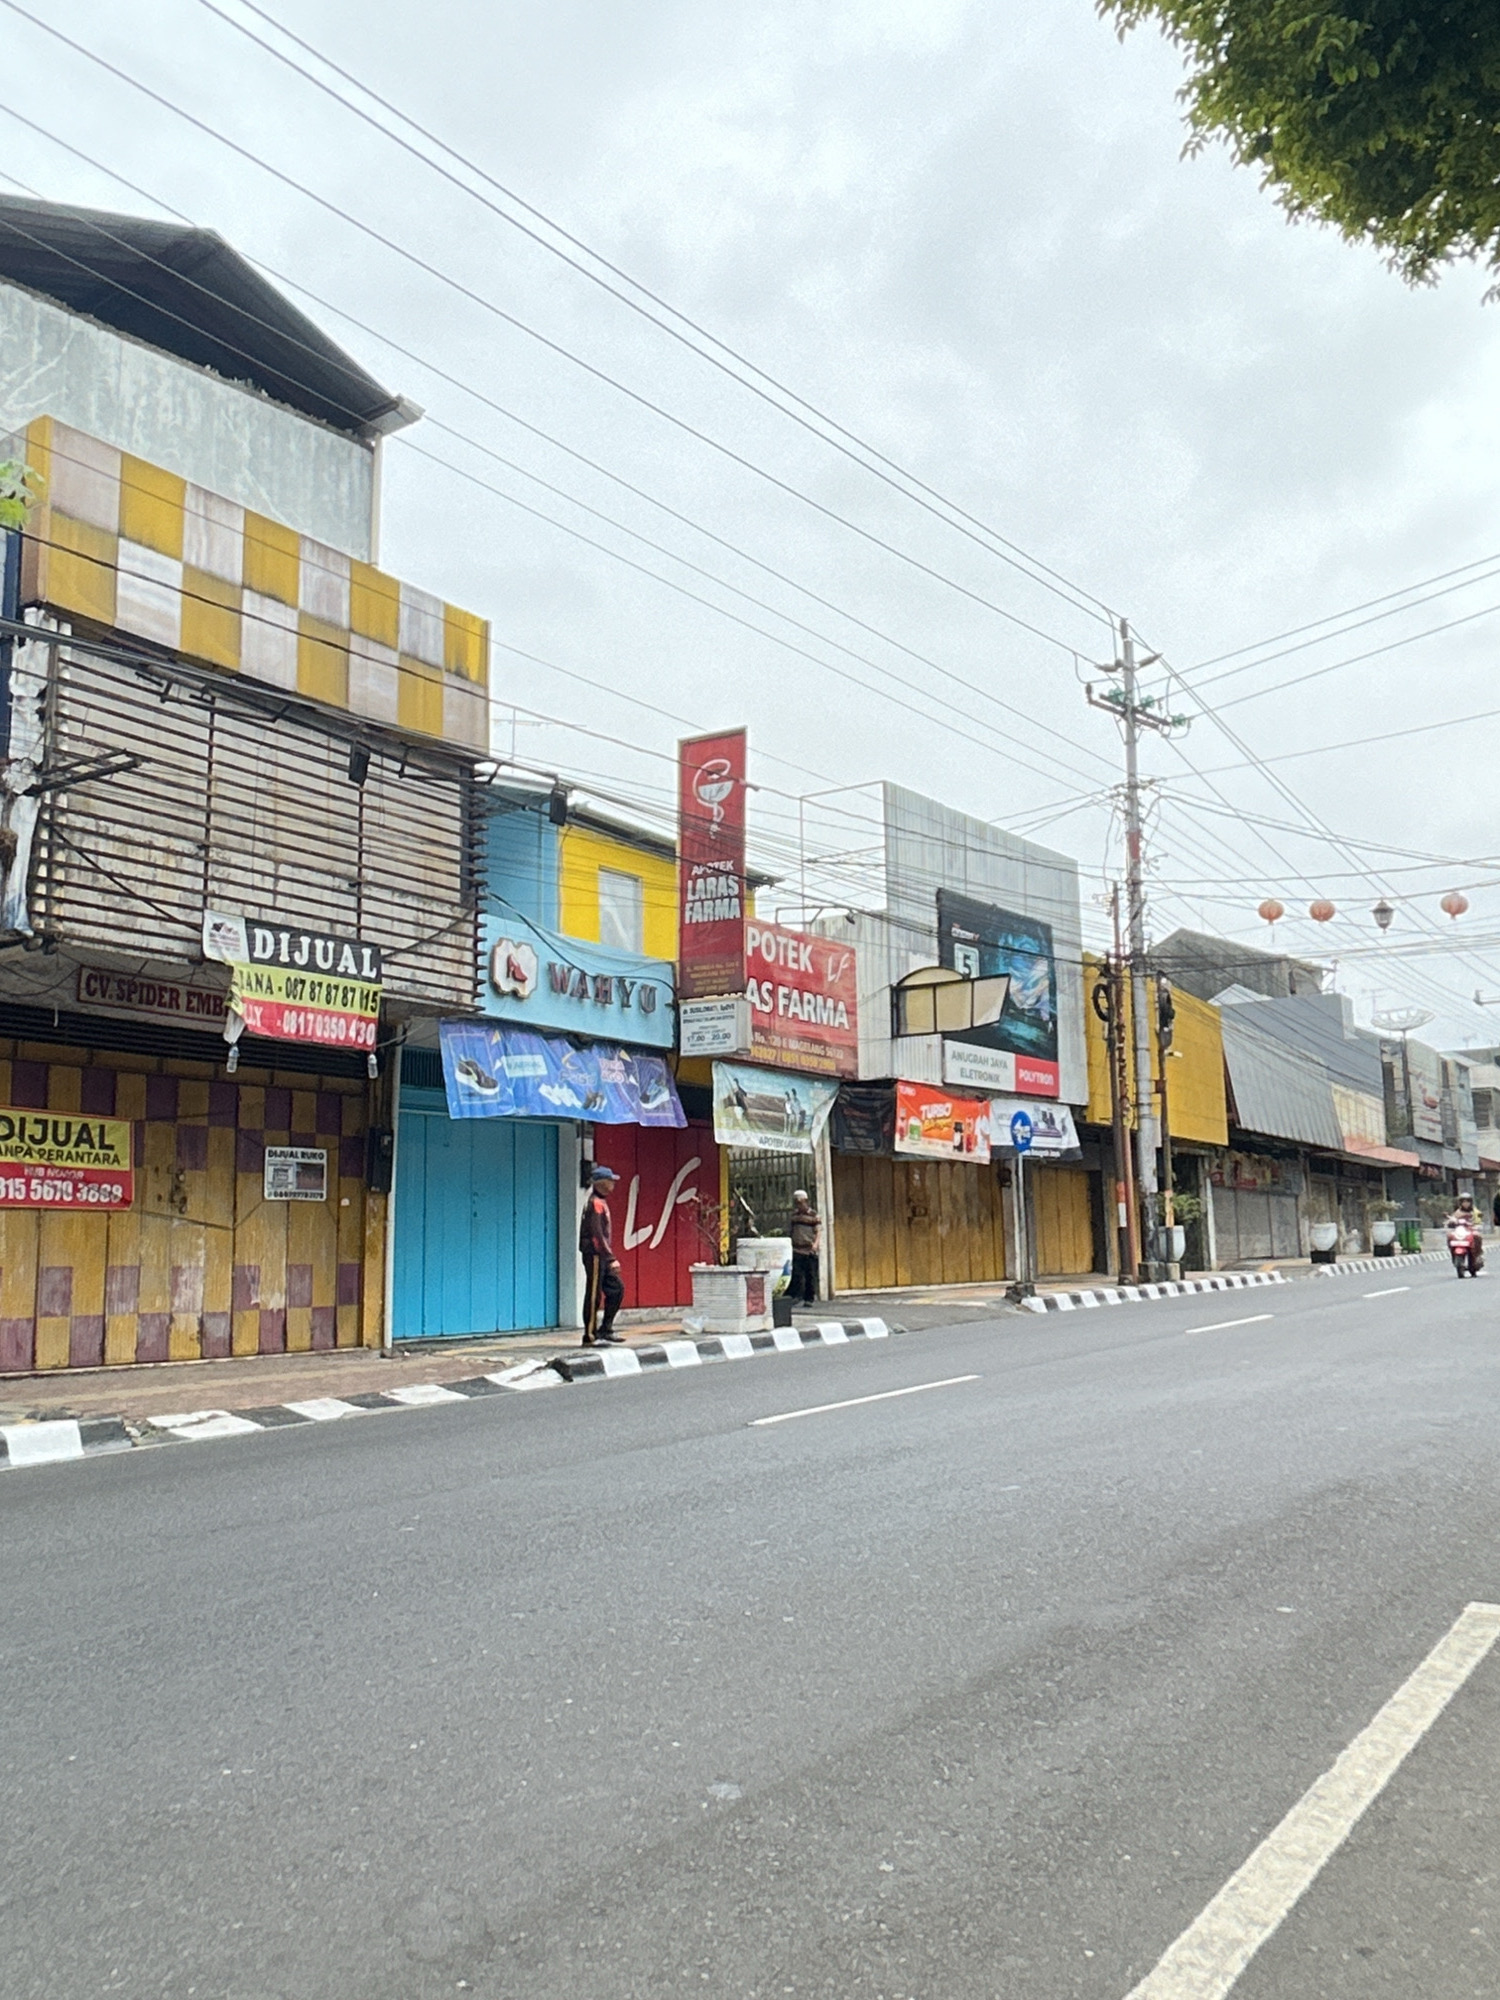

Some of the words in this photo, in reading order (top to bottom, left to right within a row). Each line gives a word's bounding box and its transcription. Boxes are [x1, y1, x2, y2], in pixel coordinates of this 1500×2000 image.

[687, 875, 739, 900] LARAS
[685, 898, 741, 924] FARMA
[253, 928, 377, 978] DIJUAL
[746, 926, 814, 974] POTEK
[85, 973, 113, 999] CV.
[116, 978, 181, 1010] SPIDER
[285, 976, 306, 1000] 087
[309, 981, 323, 1004] 87
[325, 984, 339, 1006] 87
[342, 986, 356, 1008] 87
[547, 960, 658, 1014] WAHYU
[746, 977, 774, 1013] AS
[777, 984, 850, 1030] FARMA
[952, 1050, 989, 1067] ANUGRAH
[960, 1066, 1001, 1083] ELETRONIK
[920, 1102, 952, 1120] TURBO
[0, 1115, 115, 1151] DIJUAL
[37, 1148, 121, 1166] PERANTARA
[268, 1149, 300, 1159] DIJUAL
[300, 1151, 325, 1160] RUKO
